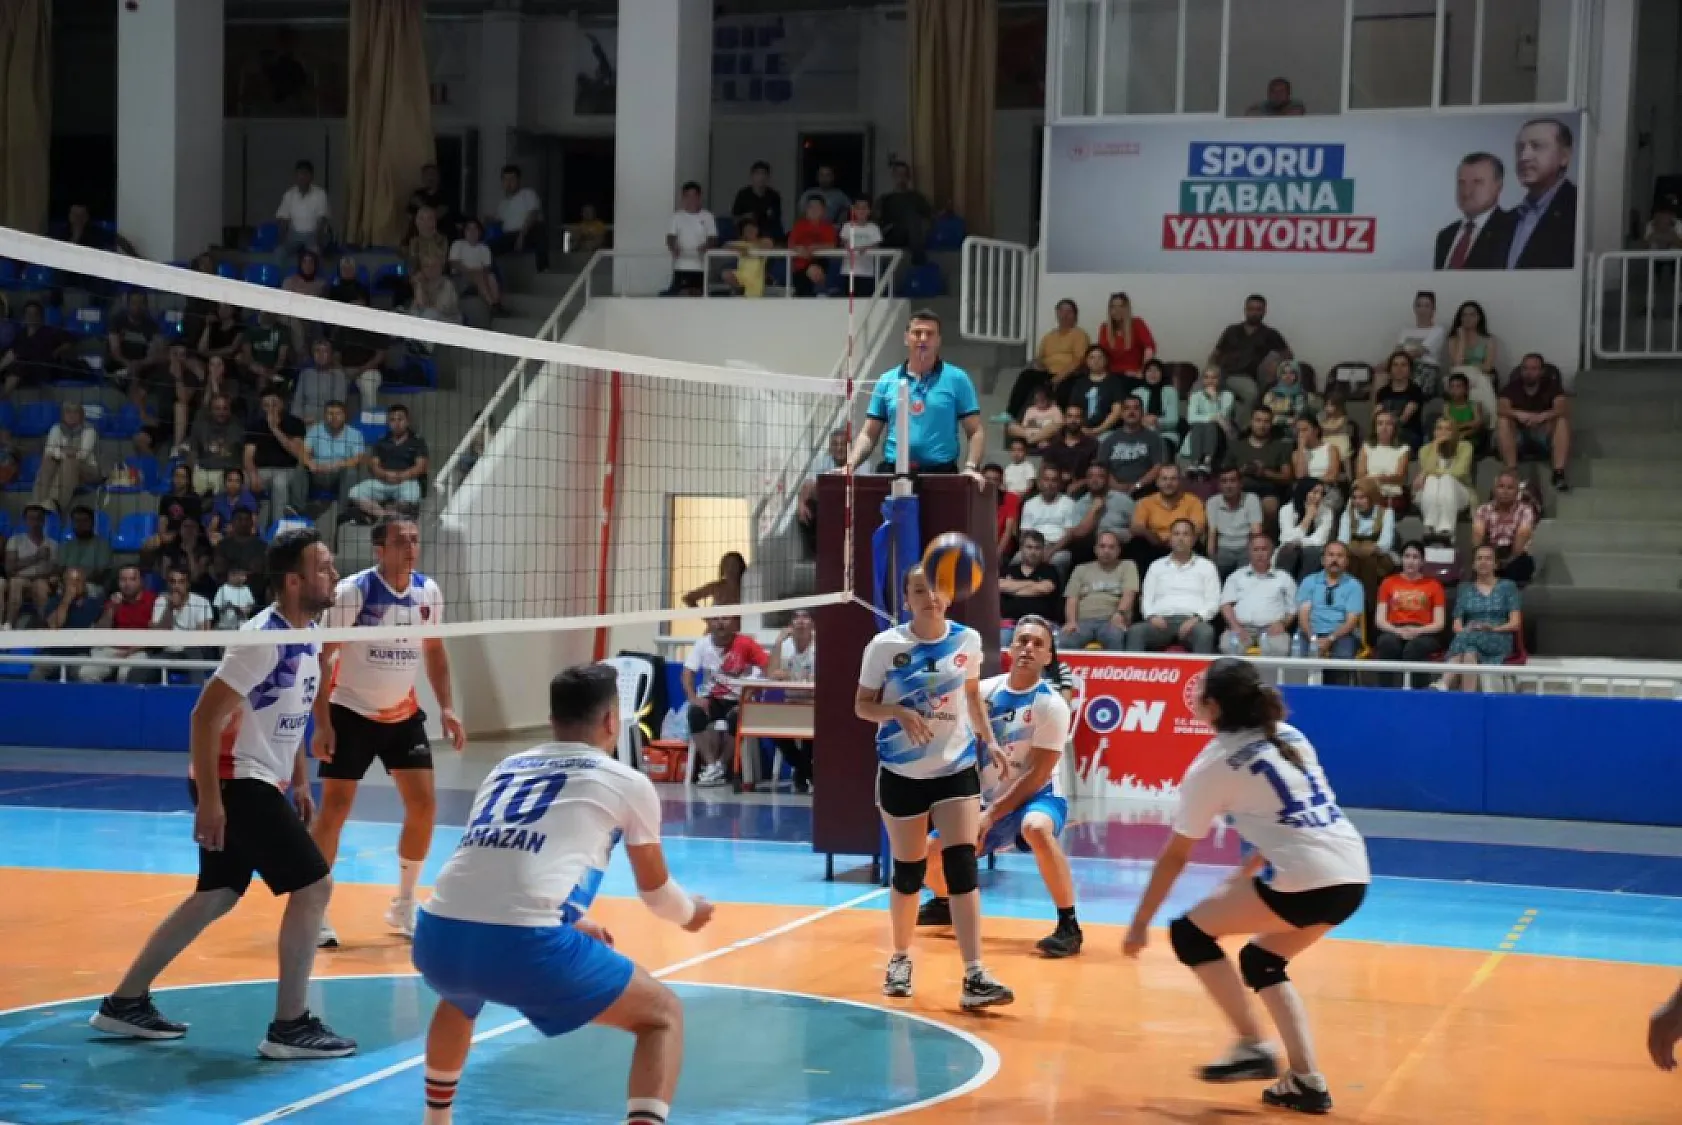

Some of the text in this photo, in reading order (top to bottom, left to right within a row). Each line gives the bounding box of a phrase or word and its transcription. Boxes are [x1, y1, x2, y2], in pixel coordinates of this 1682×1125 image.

[1200, 145, 1324, 177] SPORU
[1189, 181, 1339, 214] TABANA
[1168, 218, 1371, 250] YAYIYORUZ
[471, 772, 568, 826] 10
